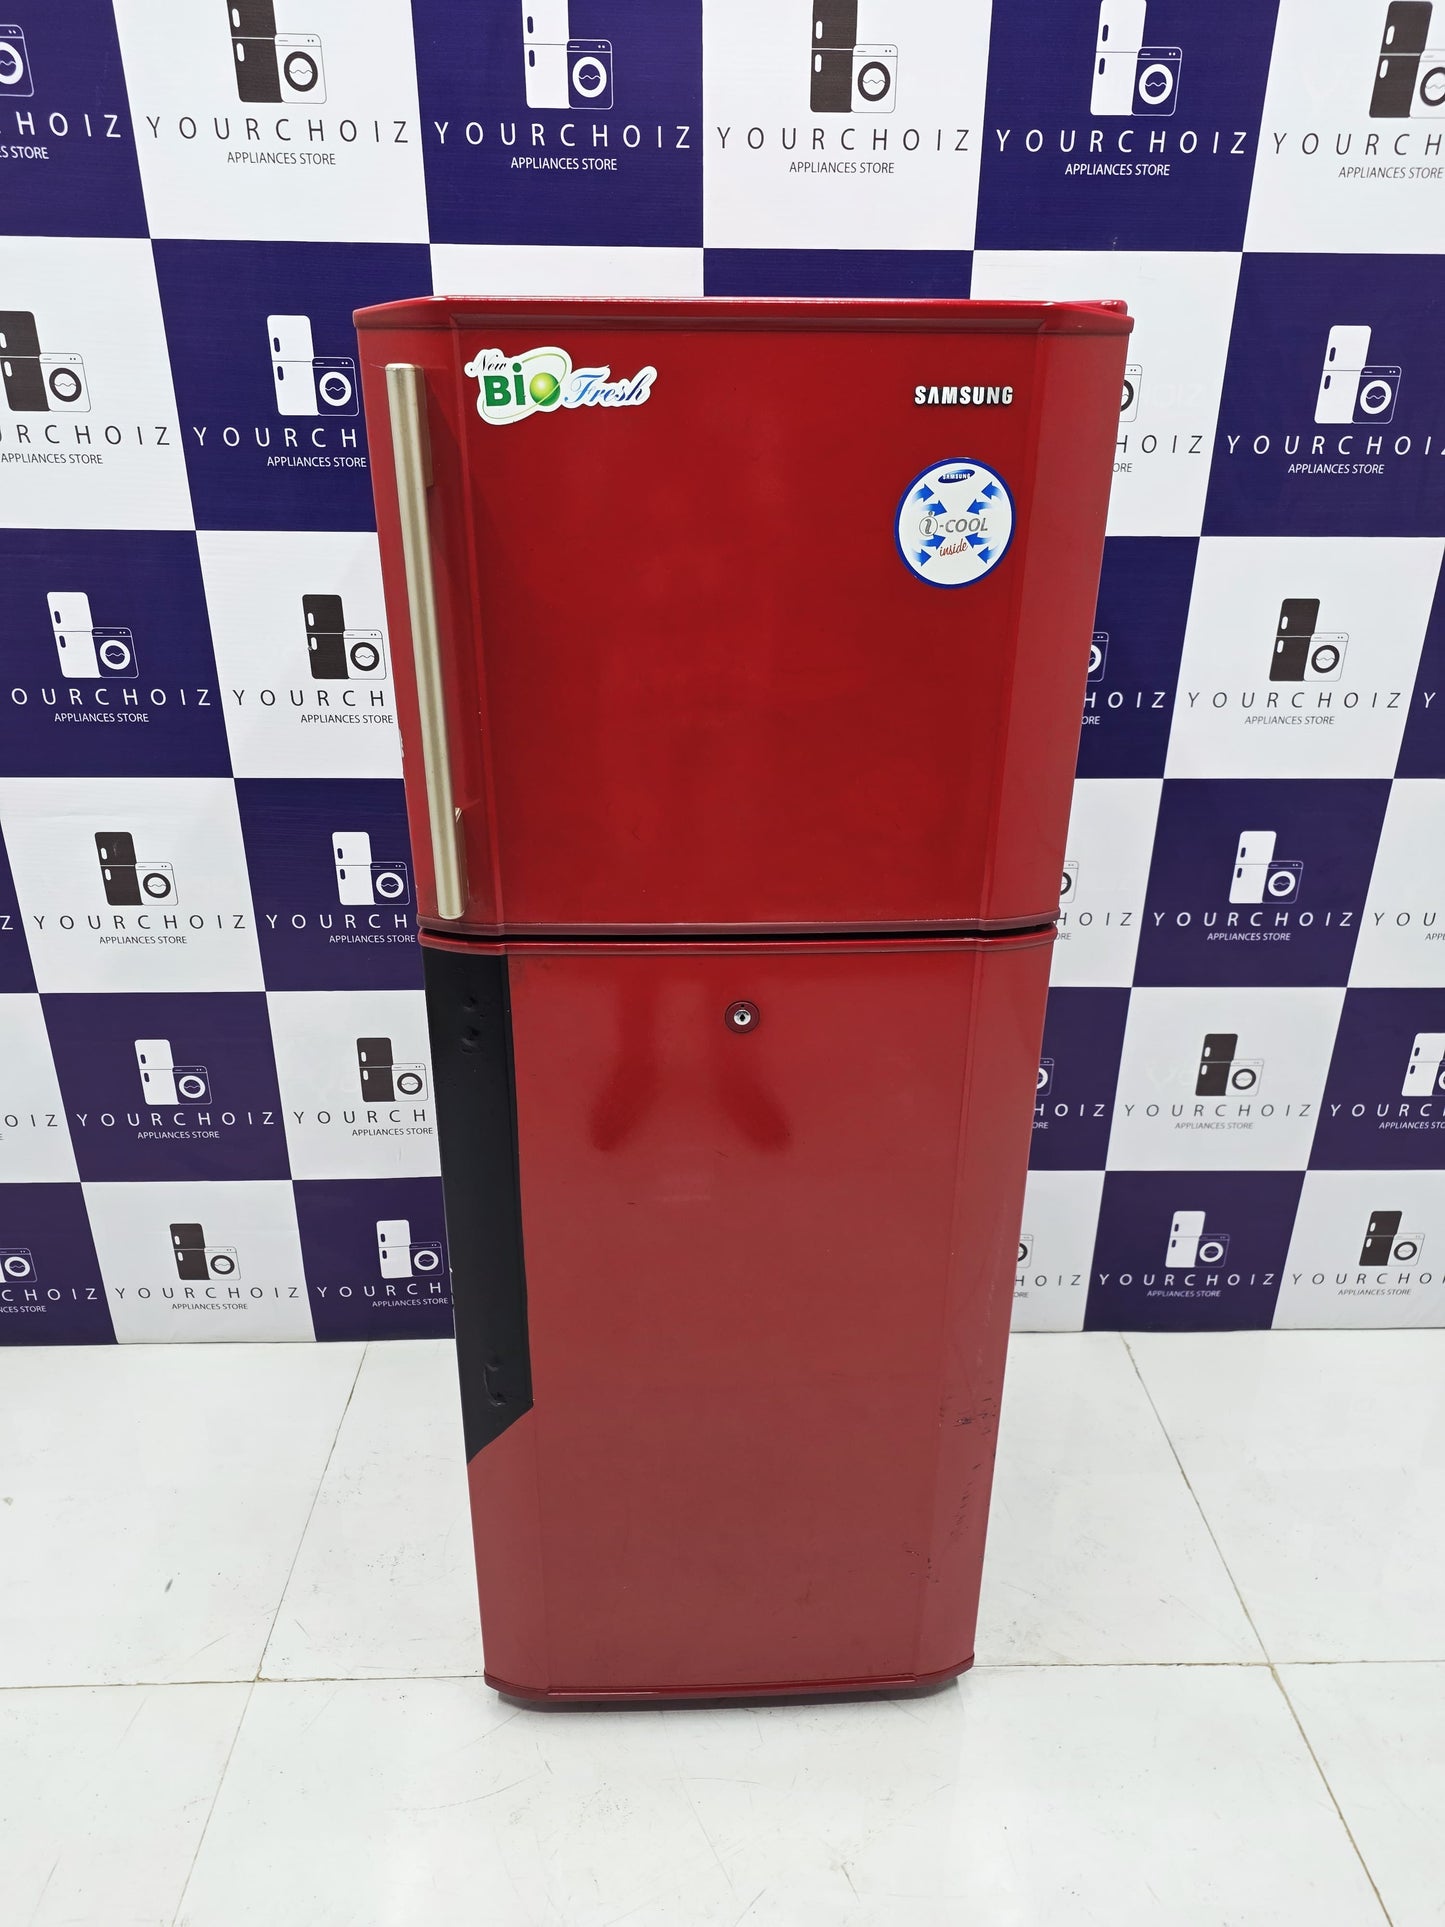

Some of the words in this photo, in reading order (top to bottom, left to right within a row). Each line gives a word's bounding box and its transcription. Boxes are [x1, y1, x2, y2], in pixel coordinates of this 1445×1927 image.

[145, 115, 409, 144] YOURCHOIZ
[433, 121, 691, 149] YOURCHOIZ
[716, 126, 970, 152] YOURCHOIZ
[996, 128, 1247, 155] YOURCHOIZ
[1273, 132, 1443, 156] YOURCH
[10, 145, 50, 160] STORE
[227, 151, 297, 165] APPLIANCES
[299, 152, 336, 166] STORE
[510, 156, 580, 170] APPLIANCES
[581, 157, 618, 171] STORE
[789, 161, 857, 174] APPLIANCES
[859, 161, 895, 174] STORE
[1064, 163, 1133, 176] APPLIANCES
[1134, 163, 1171, 176] STORE
[1337, 166, 1407, 179] APPLIANCES
[1407, 166, 1445, 180] STORE
[470, 354, 508, 373] New
[563, 373, 651, 403] Fresh
[914, 385, 1014, 406] SAMSUNG
[0, 424, 170, 446] RCHOIZ
[192, 426, 357, 448] YOURCH
[1, 452, 67, 464] APPLIANCES
[68, 453, 104, 465] STORE
[266, 456, 332, 468] APPLIANCES
[333, 456, 367, 468] STORE
[1112, 462, 1133, 474] ORE
[1287, 463, 1351, 474] APPLIANCES
[1351, 463, 1385, 475] STORE
[941, 472, 972, 481] SAMSUNG
[939, 538, 969, 557] inside
[11, 687, 211, 706] OURCHOIZ
[232, 689, 385, 707] YOURCH
[1188, 691, 1402, 709] YOURCHOIZ
[54, 712, 116, 723] APPLIANCES
[116, 712, 150, 723] STORE
[300, 714, 361, 724] APPLIANCES
[362, 714, 394, 724] STORE
[1081, 715, 1102, 726] ORE
[1244, 715, 1303, 725] APPLIANCES
[1304, 715, 1334, 725] STORE
[33, 914, 246, 930] YOURCHOIZ
[265, 913, 408, 929] YOURCH
[1153, 911, 1353, 927] YOURCHOIZ
[99, 935, 156, 945] APPLIANCES
[157, 935, 187, 945] STORE
[329, 934, 385, 944] APPLIANCES
[386, 934, 416, 943] STORE
[1206, 932, 1261, 941] APPLIANCES
[1262, 932, 1291, 941] STORE
[293, 1108, 426, 1125] YOURCH
[1124, 1103, 1312, 1118] YOURCHOIZ
[1330, 1103, 1445, 1118] YOURC
[76, 1111, 275, 1127] YOURCHOIZ
[1032, 1121, 1049, 1130] ORE
[1174, 1121, 1226, 1130] APPLIANCES
[1227, 1121, 1254, 1130] STORE
[1378, 1121, 1430, 1130] APPLIANCES
[1430, 1121, 1445, 1130] STO
[137, 1130, 191, 1140] APPLIANCES
[191, 1130, 220, 1139] STORE
[351, 1128, 405, 1137] APPLIANCES
[405, 1127, 434, 1136] STORE
[1099, 1273, 1275, 1287] YOURCHOIZ
[1292, 1272, 1445, 1285] YOURCHO
[1, 1287, 98, 1302] CHOIZ
[114, 1286, 299, 1300] YOURCHOIZ
[316, 1281, 443, 1298] YOURCH
[1013, 1290, 1029, 1299] ORE
[1146, 1290, 1195, 1298] APPLIANCES
[1196, 1289, 1221, 1298] STORE
[1337, 1288, 1385, 1296] APPLIANCES
[1387, 1288, 1411, 1296] STORE
[19, 1305, 47, 1313] STORE
[371, 1298, 422, 1308] APPLIANCES
[422, 1297, 449, 1306] STORE
